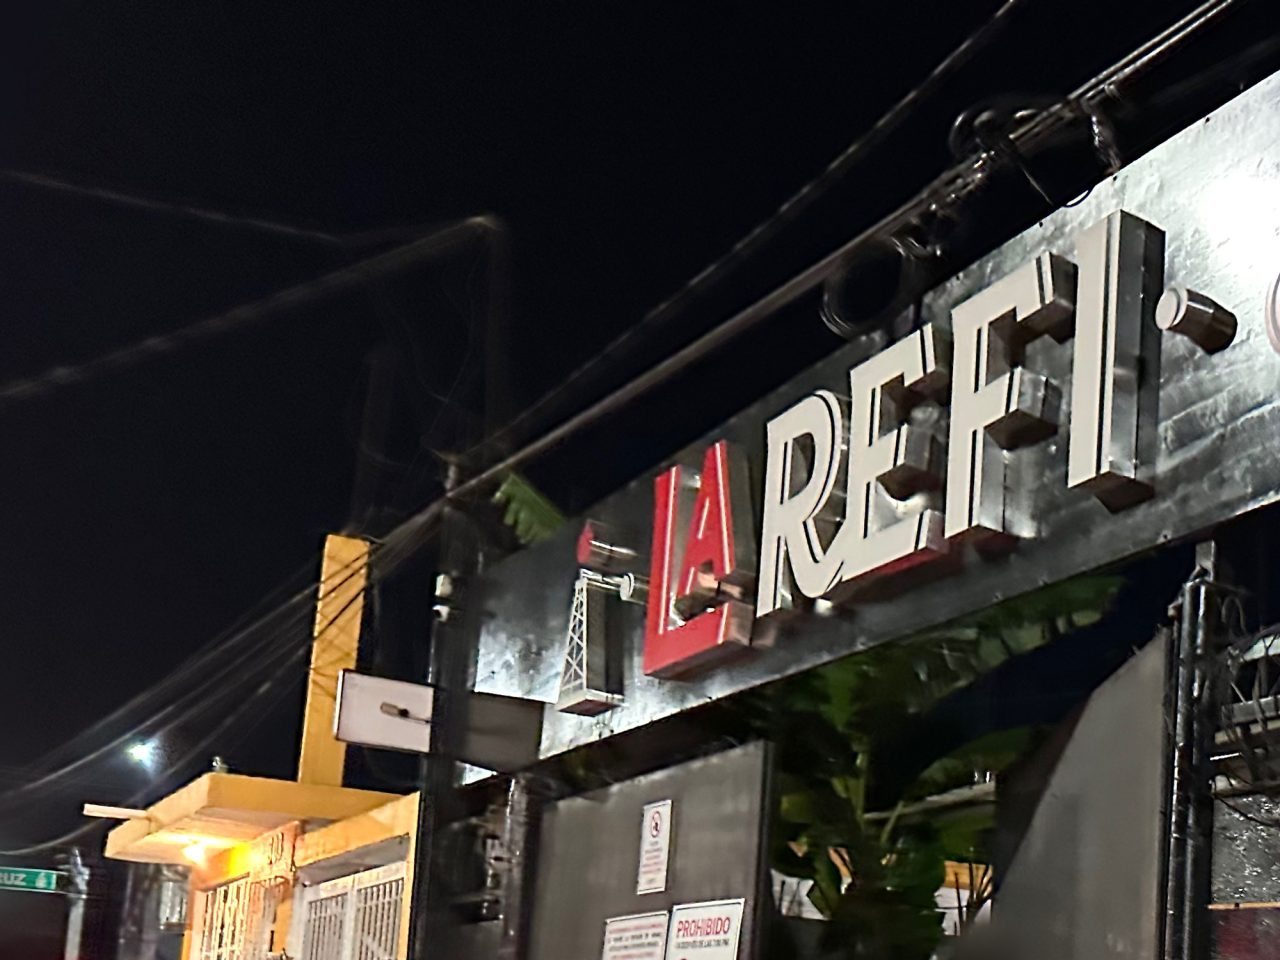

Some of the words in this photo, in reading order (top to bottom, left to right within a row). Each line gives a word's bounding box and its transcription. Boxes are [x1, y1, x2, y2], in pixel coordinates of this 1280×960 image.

[644, 440, 736, 676] LA
[756, 208, 1126, 618] REFI
[676, 916, 731, 938] PROHIBIDO
